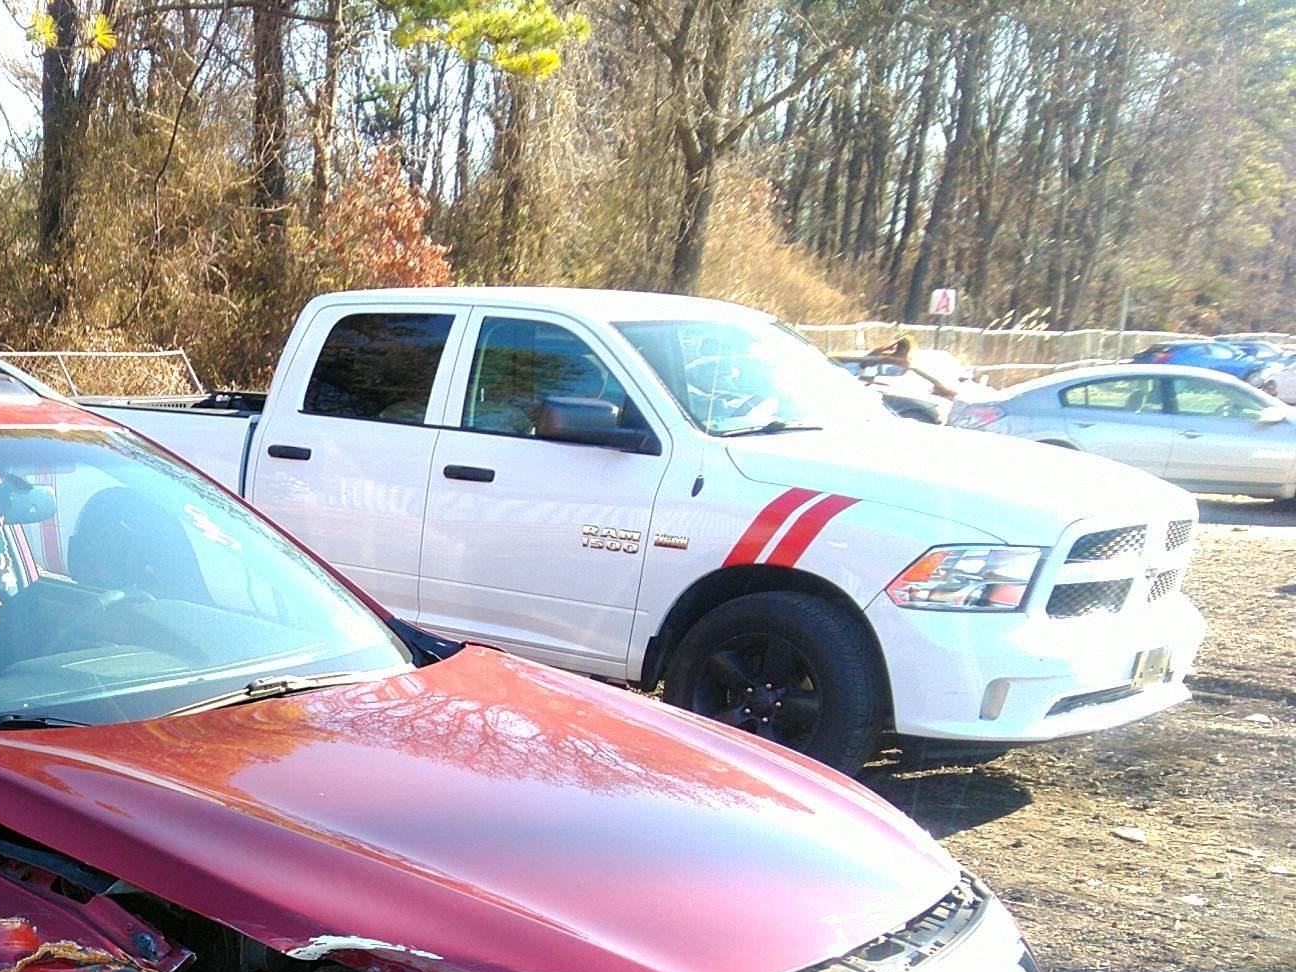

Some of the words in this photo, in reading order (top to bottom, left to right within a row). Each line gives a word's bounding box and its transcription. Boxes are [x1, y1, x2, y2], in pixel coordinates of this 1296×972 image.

[935, 290, 950, 312] A
[582, 524, 641, 542] RAM
[582, 537, 639, 554] 1500
